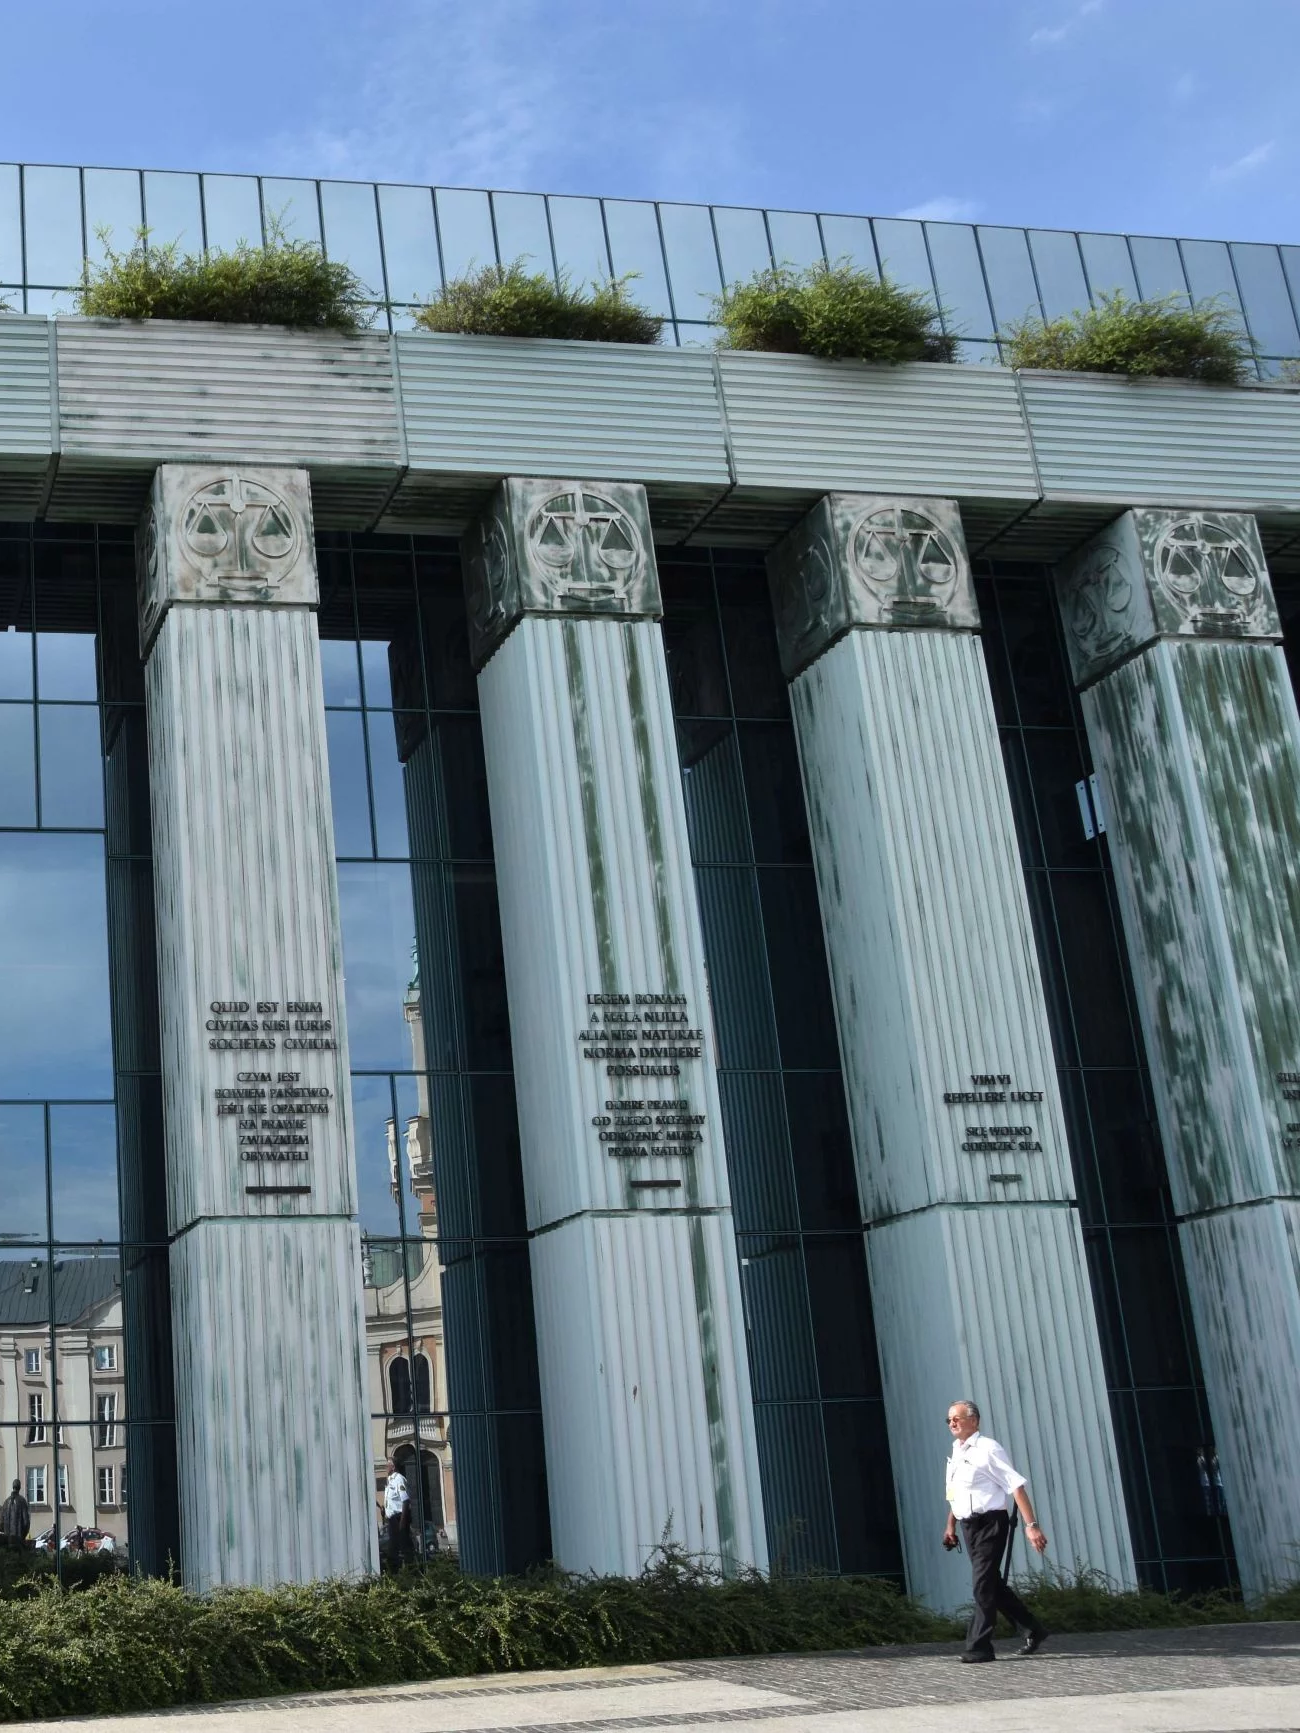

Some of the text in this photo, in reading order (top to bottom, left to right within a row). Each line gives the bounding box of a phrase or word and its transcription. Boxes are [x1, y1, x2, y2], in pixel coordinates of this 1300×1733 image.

[587, 994, 687, 1004] LEGEM BONAM
[210, 1002, 322, 1014] QUID EST ENIM
[591, 1012, 688, 1022] A MALA NULLA
[206, 1020, 332, 1031] CIVITAS NISI IURIS
[579, 1030, 704, 1040] ALIA NISI NATURAE
[209, 1039, 338, 1049] SOCIETAS CIVIUM
[584, 1047, 701, 1058] NORMA DIVIDERE
[607, 1065, 680, 1076] POSSUMUS
[237, 1072, 301, 1083] CZYM JEST
[971, 1075, 1011, 1085] VIM VI
[215, 1089, 266, 1098] BOWIEM
[944, 1092, 1044, 1103] REPELLERE LICET
[217, 1102, 329, 1116] JEŚLI NIE OPARTYM
[606, 1101, 687, 1109] DOBRE PRAWO
[240, 1120, 307, 1129] NA PRAWIE
[592, 1117, 611, 1126] OD
[989, 1127, 1033, 1136] WOLNO
[239, 1135, 309, 1147] ZWIĄZKIEM
[241, 1151, 308, 1161] OBYWATELI
[608, 1147, 695, 1156] PRAWA NATURY
